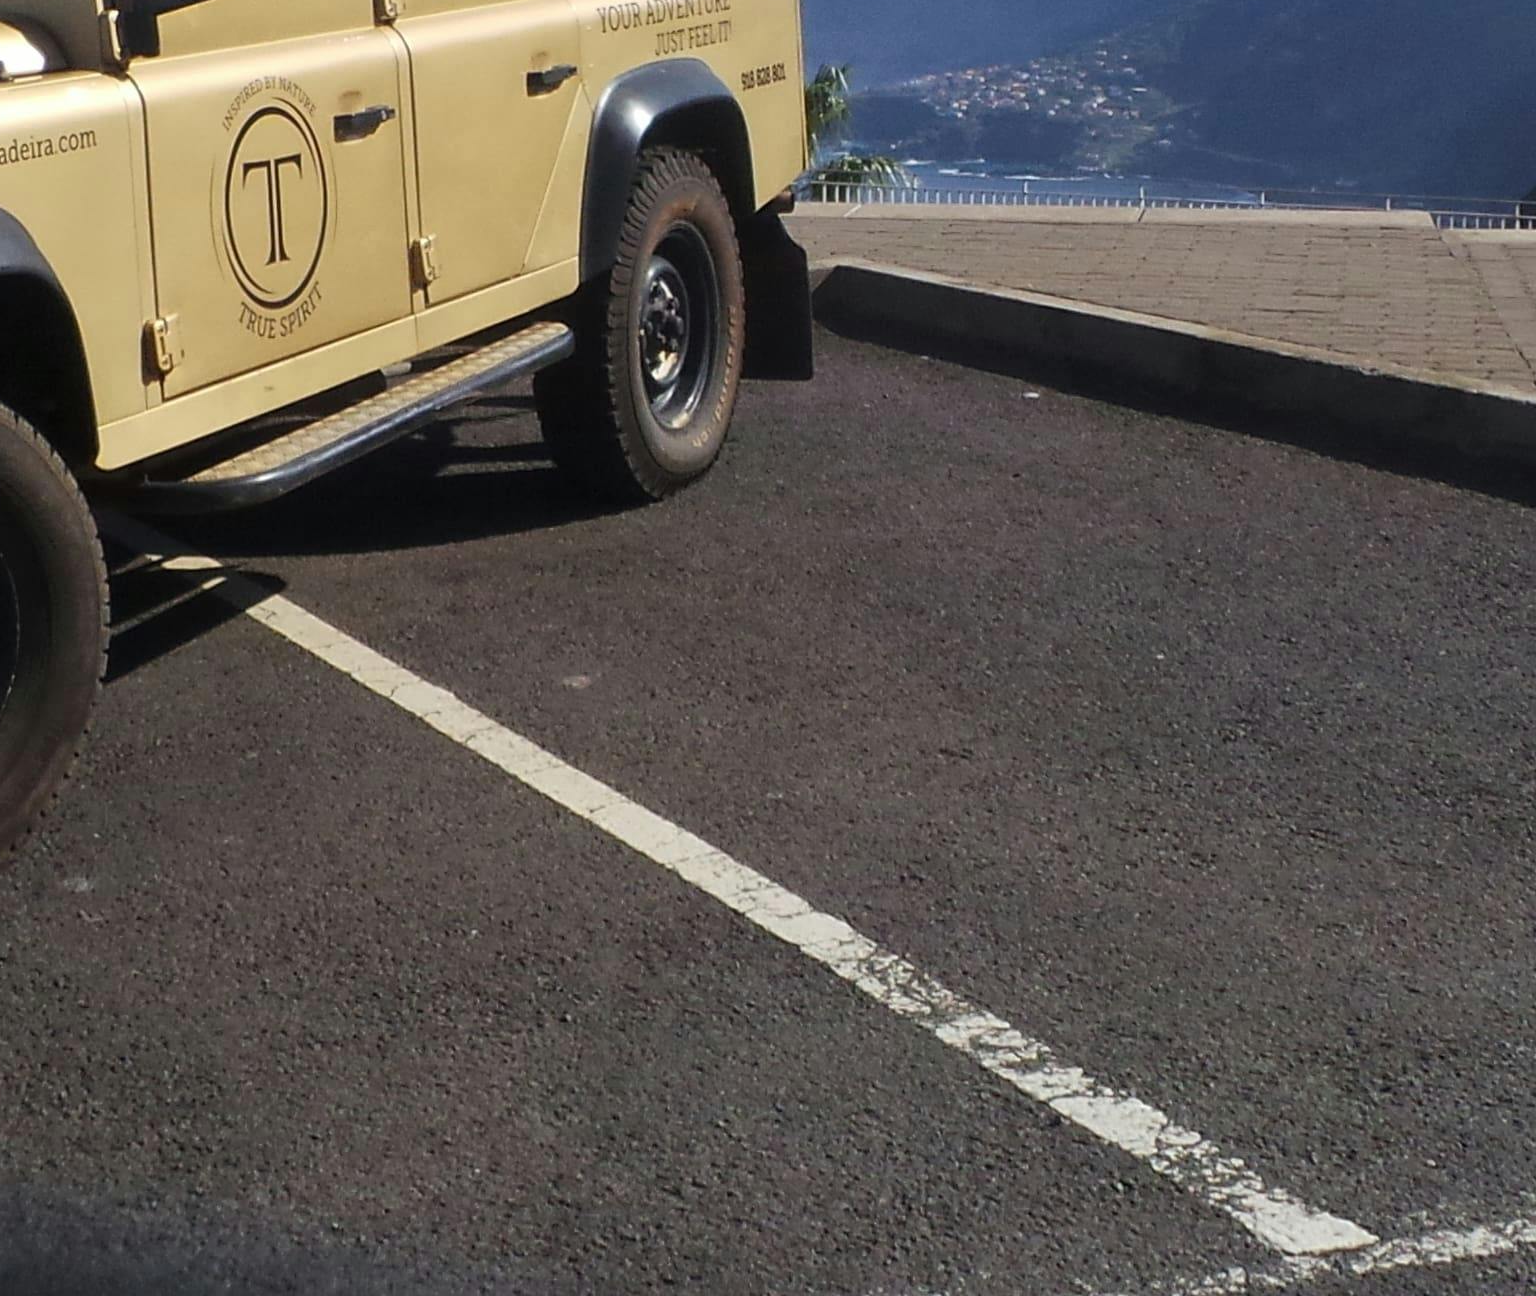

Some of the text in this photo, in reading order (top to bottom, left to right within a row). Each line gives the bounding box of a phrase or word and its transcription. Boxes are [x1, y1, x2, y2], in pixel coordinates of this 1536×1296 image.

[597, 2, 643, 34] YOUR
[655, 28, 685, 56] JUST
[687, 23, 716, 49] FEEL
[222, 75, 317, 132] INSPIRED BY NATURE
[242, 152, 303, 266] T
[238, 281, 323, 339] TRUE SPIRIT
